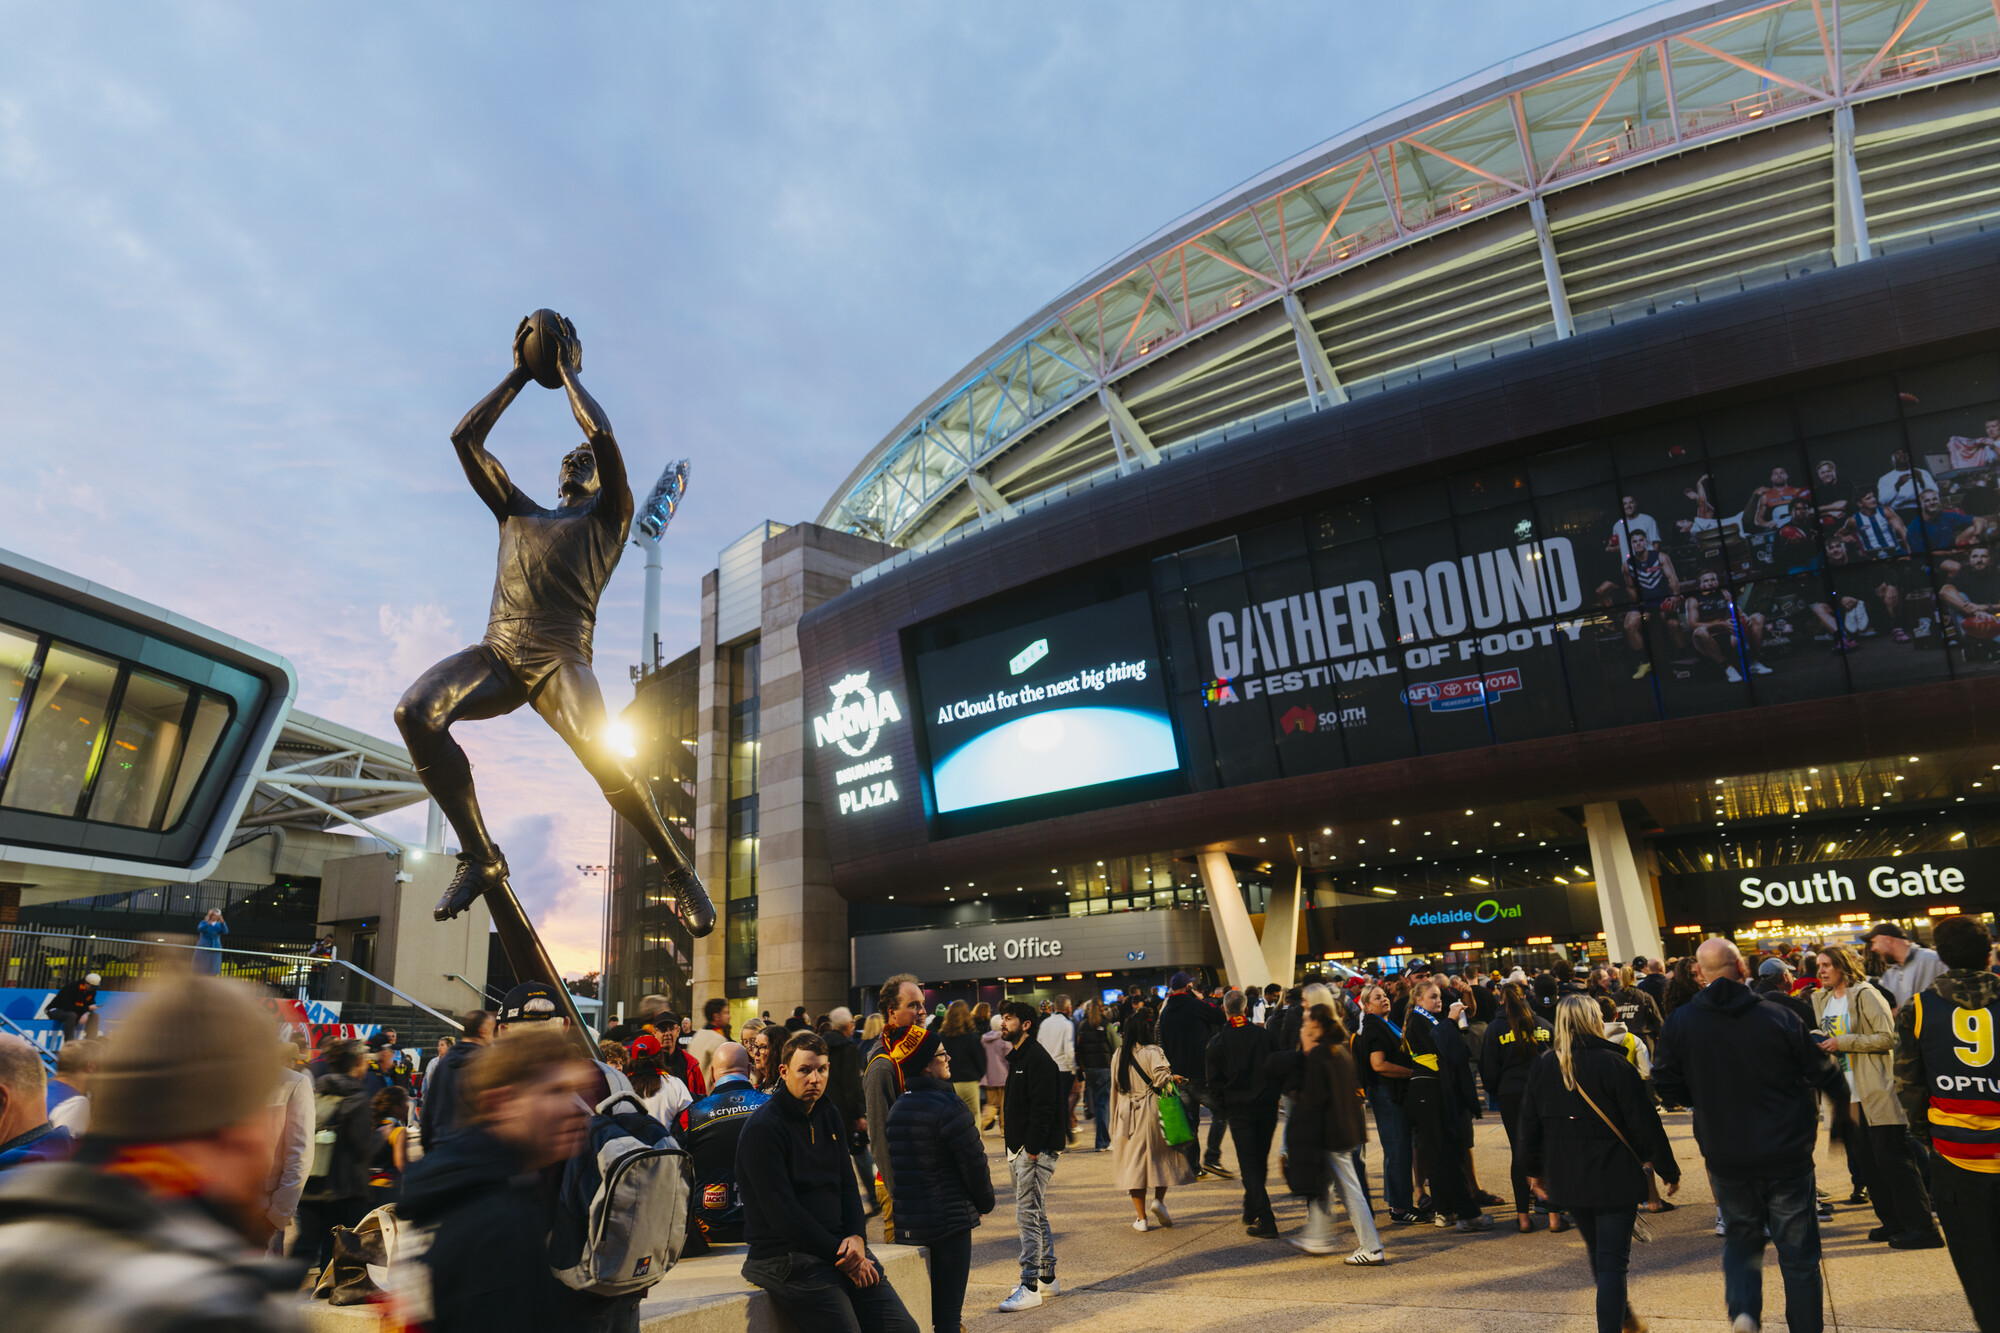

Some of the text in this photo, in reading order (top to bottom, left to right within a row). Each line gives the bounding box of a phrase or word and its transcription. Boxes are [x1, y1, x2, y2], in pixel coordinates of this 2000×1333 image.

[1208, 537, 1583, 680] GATHER ROUND
[1219, 619, 1585, 706] A FESTIVAL OF FOOTY
[937, 659, 1147, 724] AI Cloud for the next big thing
[1409, 675, 1517, 701] AFL TOYOTA
[814, 690, 902, 748] NRMA
[1318, 706, 1367, 725] SOUTH
[1321, 720, 1368, 732] AUSRALIA
[836, 755, 894, 786] INSURANCE
[839, 779, 900, 815] PLAZA
[1740, 863, 1966, 908] South Gate
[1409, 899, 1522, 926] Adelaide Oval
[943, 937, 1063, 963] Ticket Office
[1617, 1004, 1640, 1013] WHITE
[1622, 1012, 1636, 1020] FOX
[898, 1028, 924, 1056] CROWS
[1952, 1006, 1995, 1067] 9
[716, 1103, 762, 1116] crypto.co
